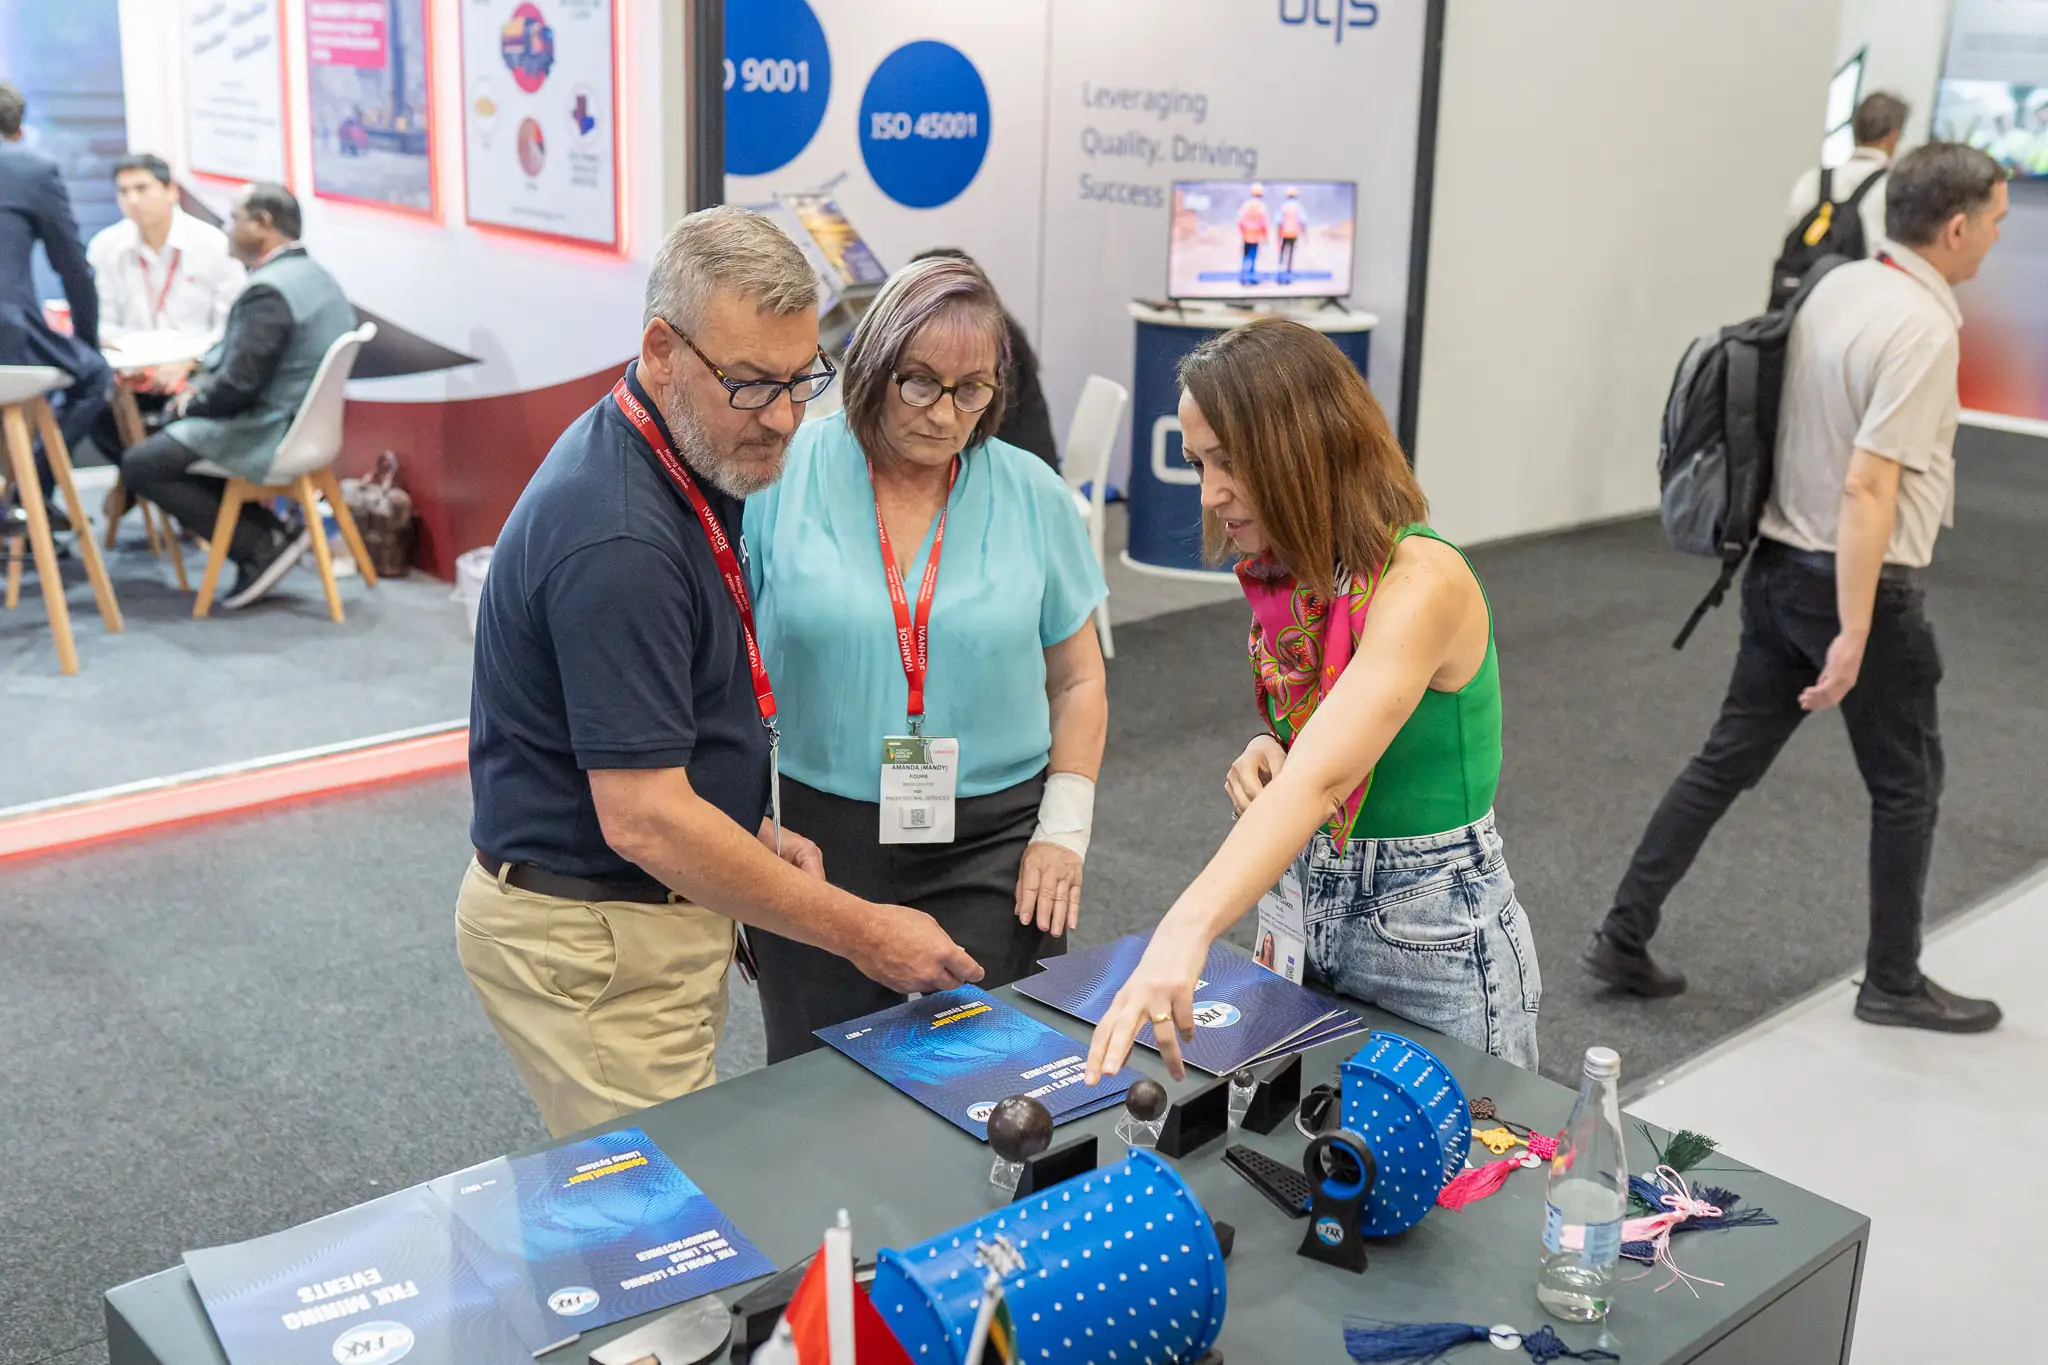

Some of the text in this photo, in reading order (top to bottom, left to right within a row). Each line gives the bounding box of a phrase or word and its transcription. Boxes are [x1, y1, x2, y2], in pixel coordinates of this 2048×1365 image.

[741, 57, 809, 92] 9001
[1082, 81, 1208, 124] Leveraging
[871, 112, 978, 140] ISO 45001
[1172, 133, 1258, 179] Driving
[1079, 172, 1164, 209] Success
[702, 506, 729, 552] IVANHOE
[899, 627, 914, 672] IVANHOE
[718, 1247, 738, 1261] THE
[297, 1267, 383, 1303] EVENTS
[281, 1293, 371, 1330] MINING
